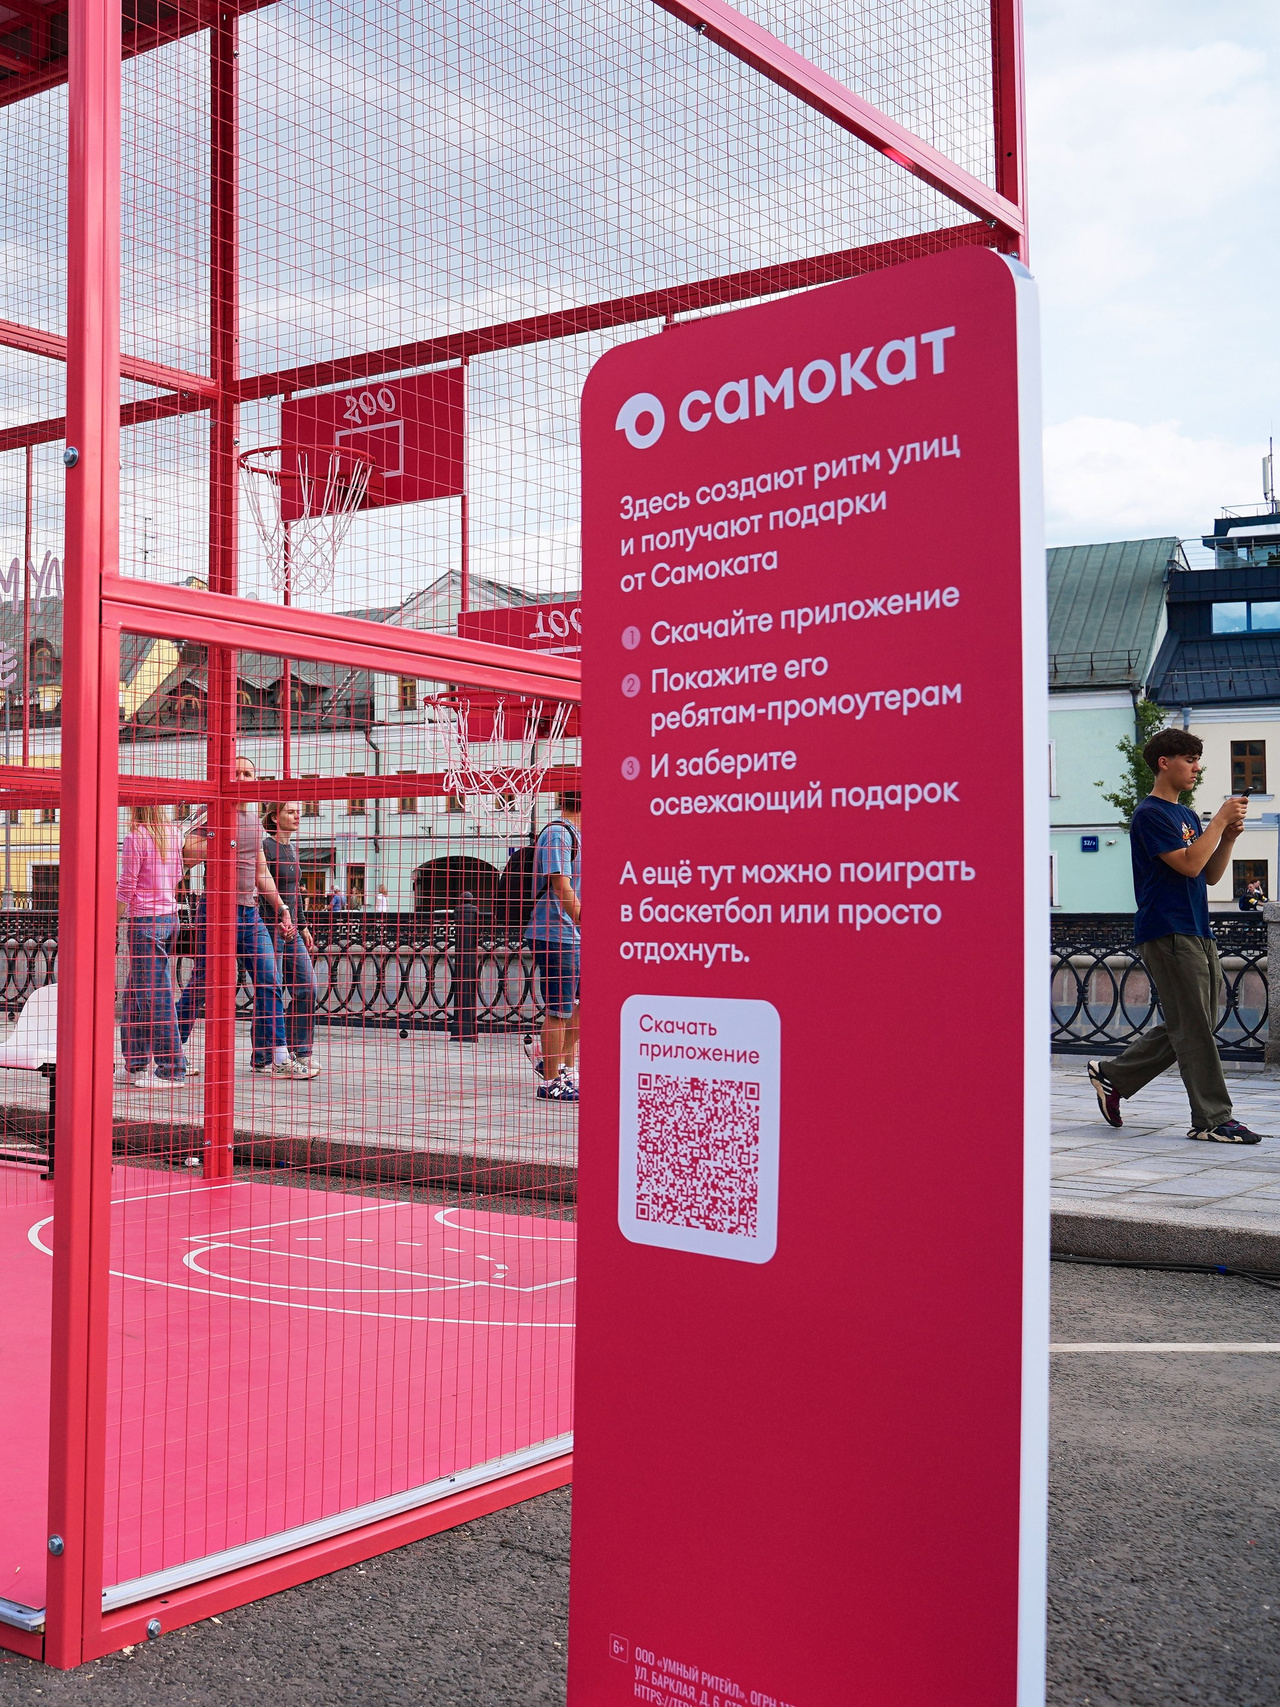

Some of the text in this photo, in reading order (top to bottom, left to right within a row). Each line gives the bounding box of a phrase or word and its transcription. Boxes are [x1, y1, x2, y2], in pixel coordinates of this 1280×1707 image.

[679, 326, 955, 432] самокат
[343, 387, 396, 424] 200
[620, 435, 960, 521] Здесь создают ритм улиц
[621, 491, 886, 556] и получают подарки
[621, 551, 777, 592] от Самоката
[651, 609, 773, 645] Скачайте
[781, 587, 959, 634] приложение
[652, 663, 777, 693] Покажите
[784, 657, 828, 679] его
[652, 684, 961, 737] ребятам-промоутерам
[652, 753, 668, 778] И
[676, 748, 796, 779] заберите
[650, 781, 959, 815] освежающий подарок
[620, 860, 975, 890] А ещё тут можно поиграть
[621, 897, 941, 931] в баскетбол или просто
[620, 942, 749, 968] отдохнуть.
[639, 1013, 718, 1036] Скачать
[639, 1042, 760, 1065] приложение
[613, 1640, 624, 1655] 6+
[635, 1647, 655, 1666] ООО
[657, 1656, 699, 1683] «УМНЫЙ
[634, 1664, 648, 1682] УЛ.
[651, 1671, 697, 1702] БАРКЛАЯ,
